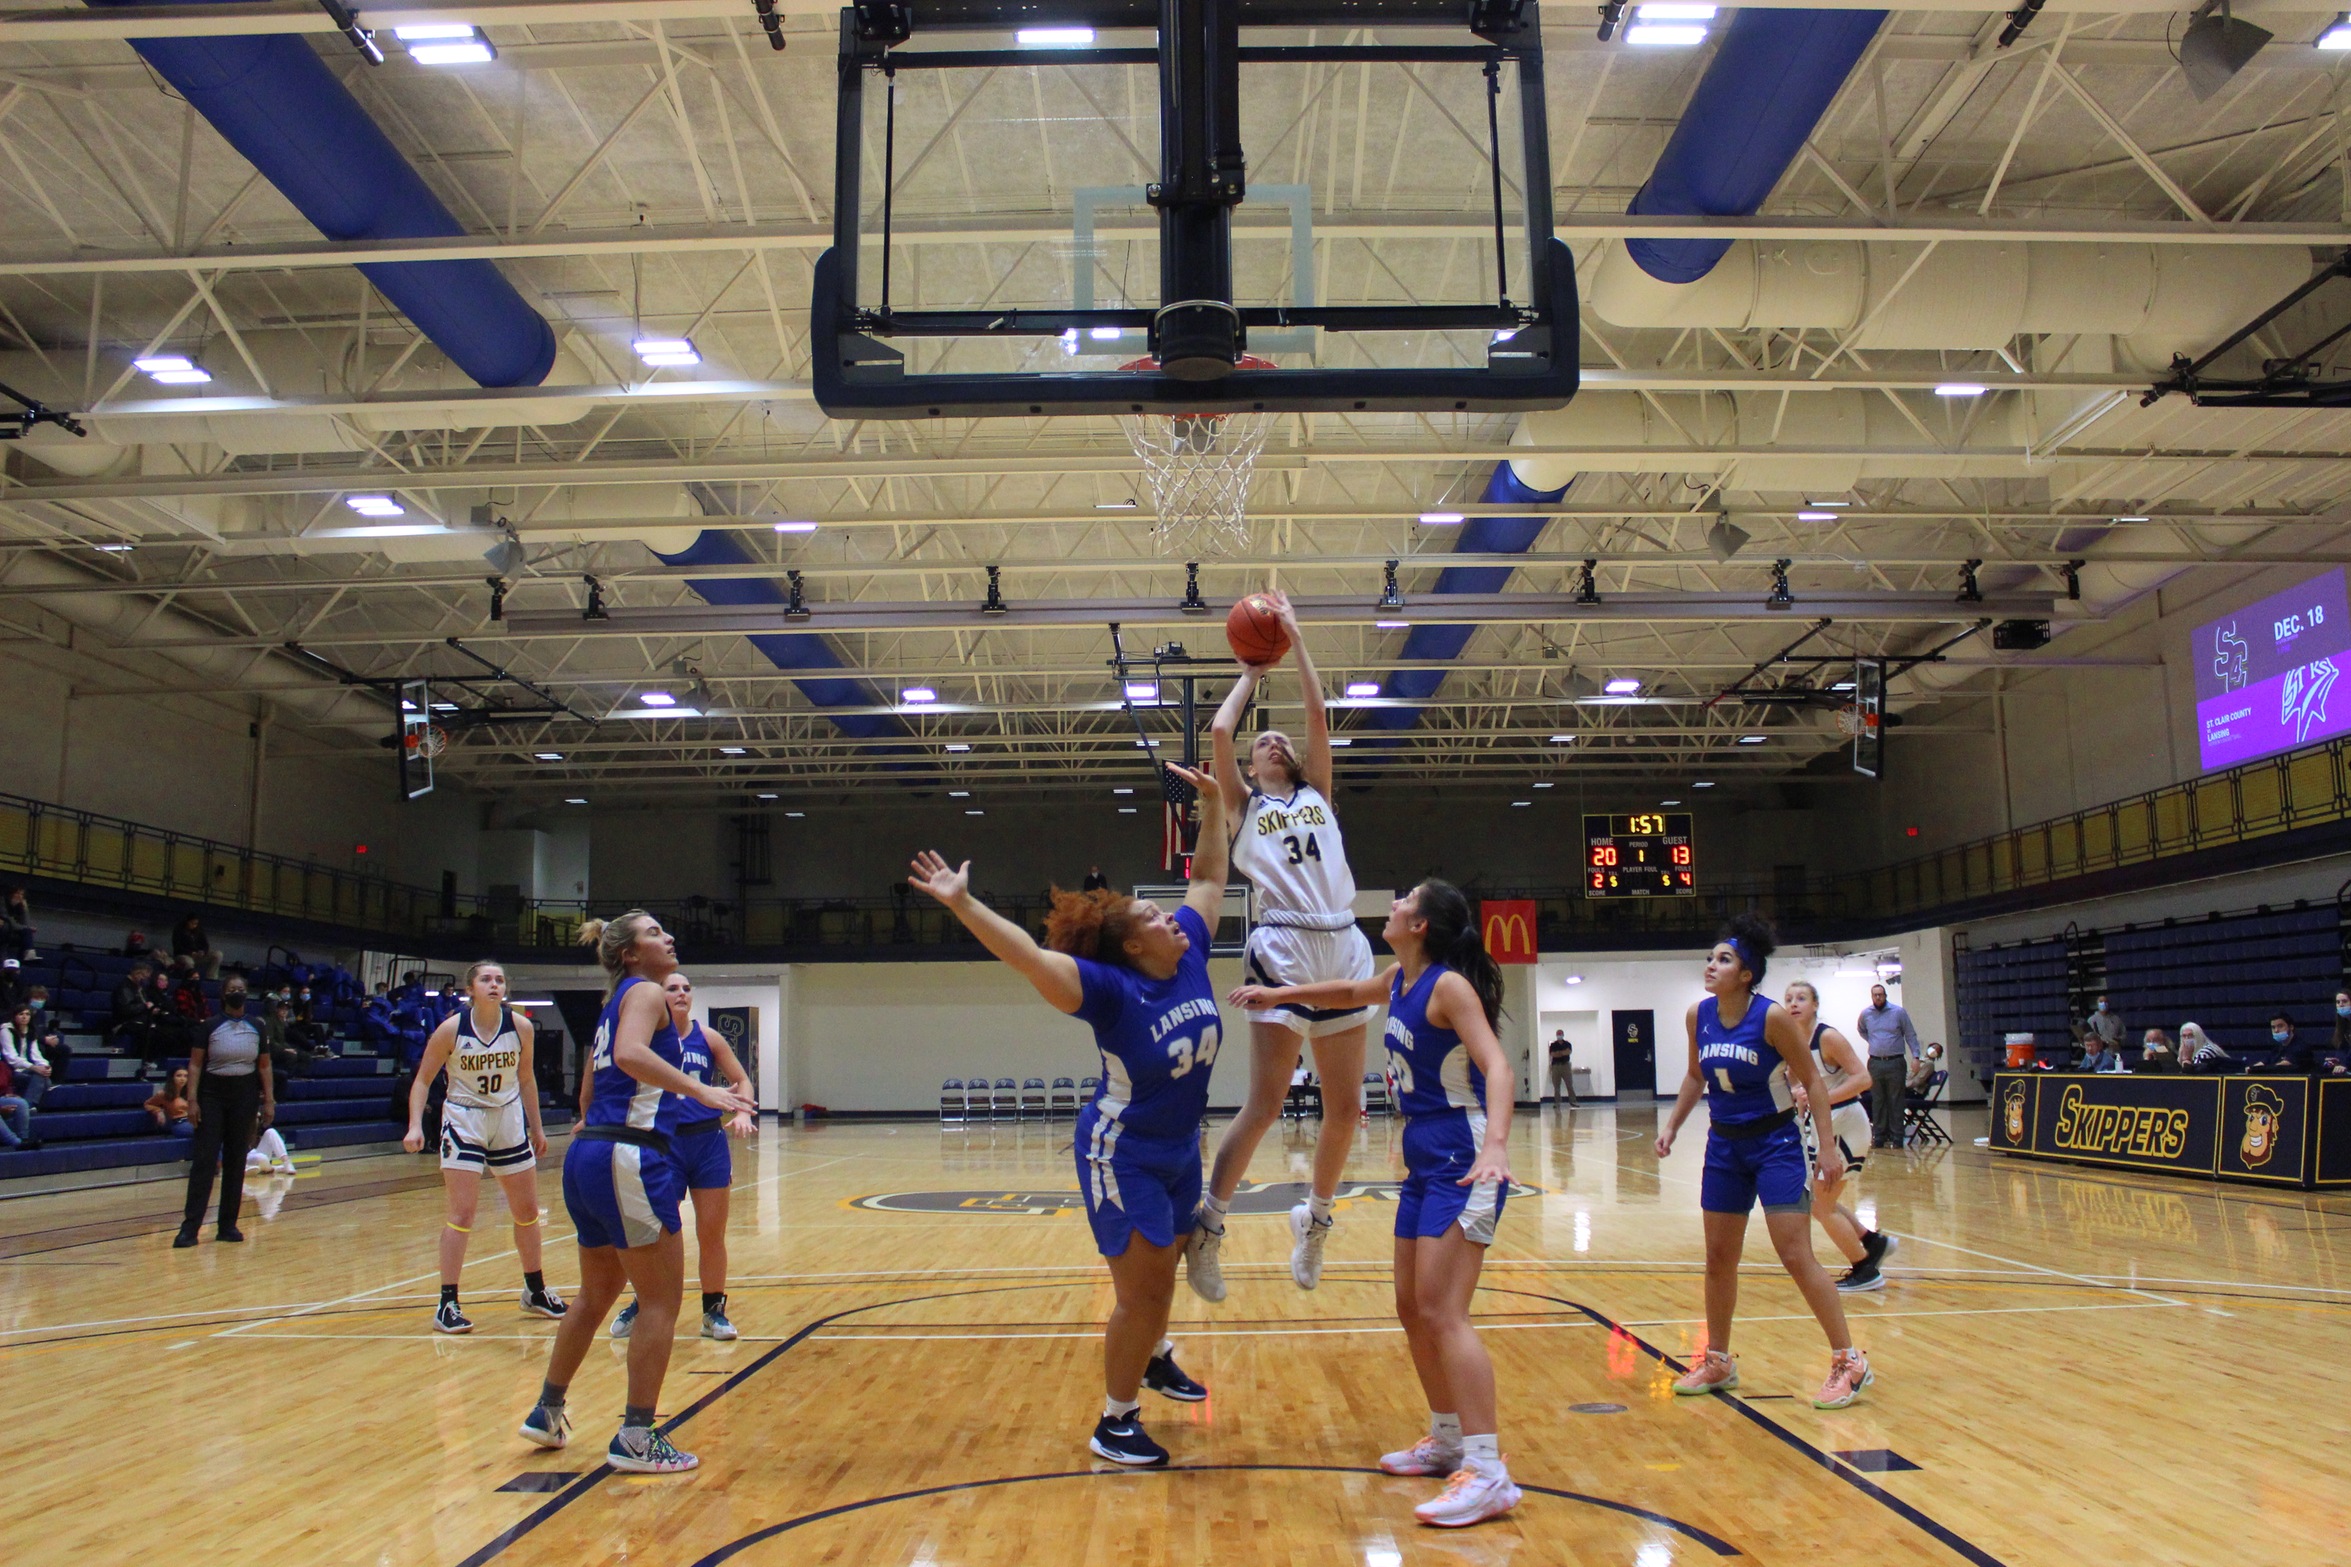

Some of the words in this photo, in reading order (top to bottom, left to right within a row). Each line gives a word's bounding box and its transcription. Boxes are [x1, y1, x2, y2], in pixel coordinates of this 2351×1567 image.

[2274, 614, 2304, 641] DEC.
[2307, 605, 2324, 627] 18
[2214, 714, 2230, 726] CLAIR
[2230, 707, 2252, 721] COUNTY
[2208, 728, 2230, 742] LANSING
[1258, 805, 1326, 836] SKIPPERS
[1630, 815, 1664, 834] 1:57
[1283, 832, 1321, 865] 34
[1591, 838, 1614, 846] HOME
[1662, 836, 1688, 845] GUEST
[1593, 847, 1617, 866] 20
[1638, 849, 1644, 863] 1
[1672, 846, 1690, 864] 13
[1593, 874, 1604, 888] 2
[1680, 872, 1691, 886] 4
[1150, 998, 1218, 1043] LANSING
[460, 1051, 516, 1071] SKIPPERS
[1167, 1024, 1219, 1080] 34
[1698, 1043, 1759, 1066] LANSING
[477, 1074, 502, 1095] 30
[1714, 1068, 1736, 1094] 1
[2054, 1083, 2189, 1159] SKIPPERS
